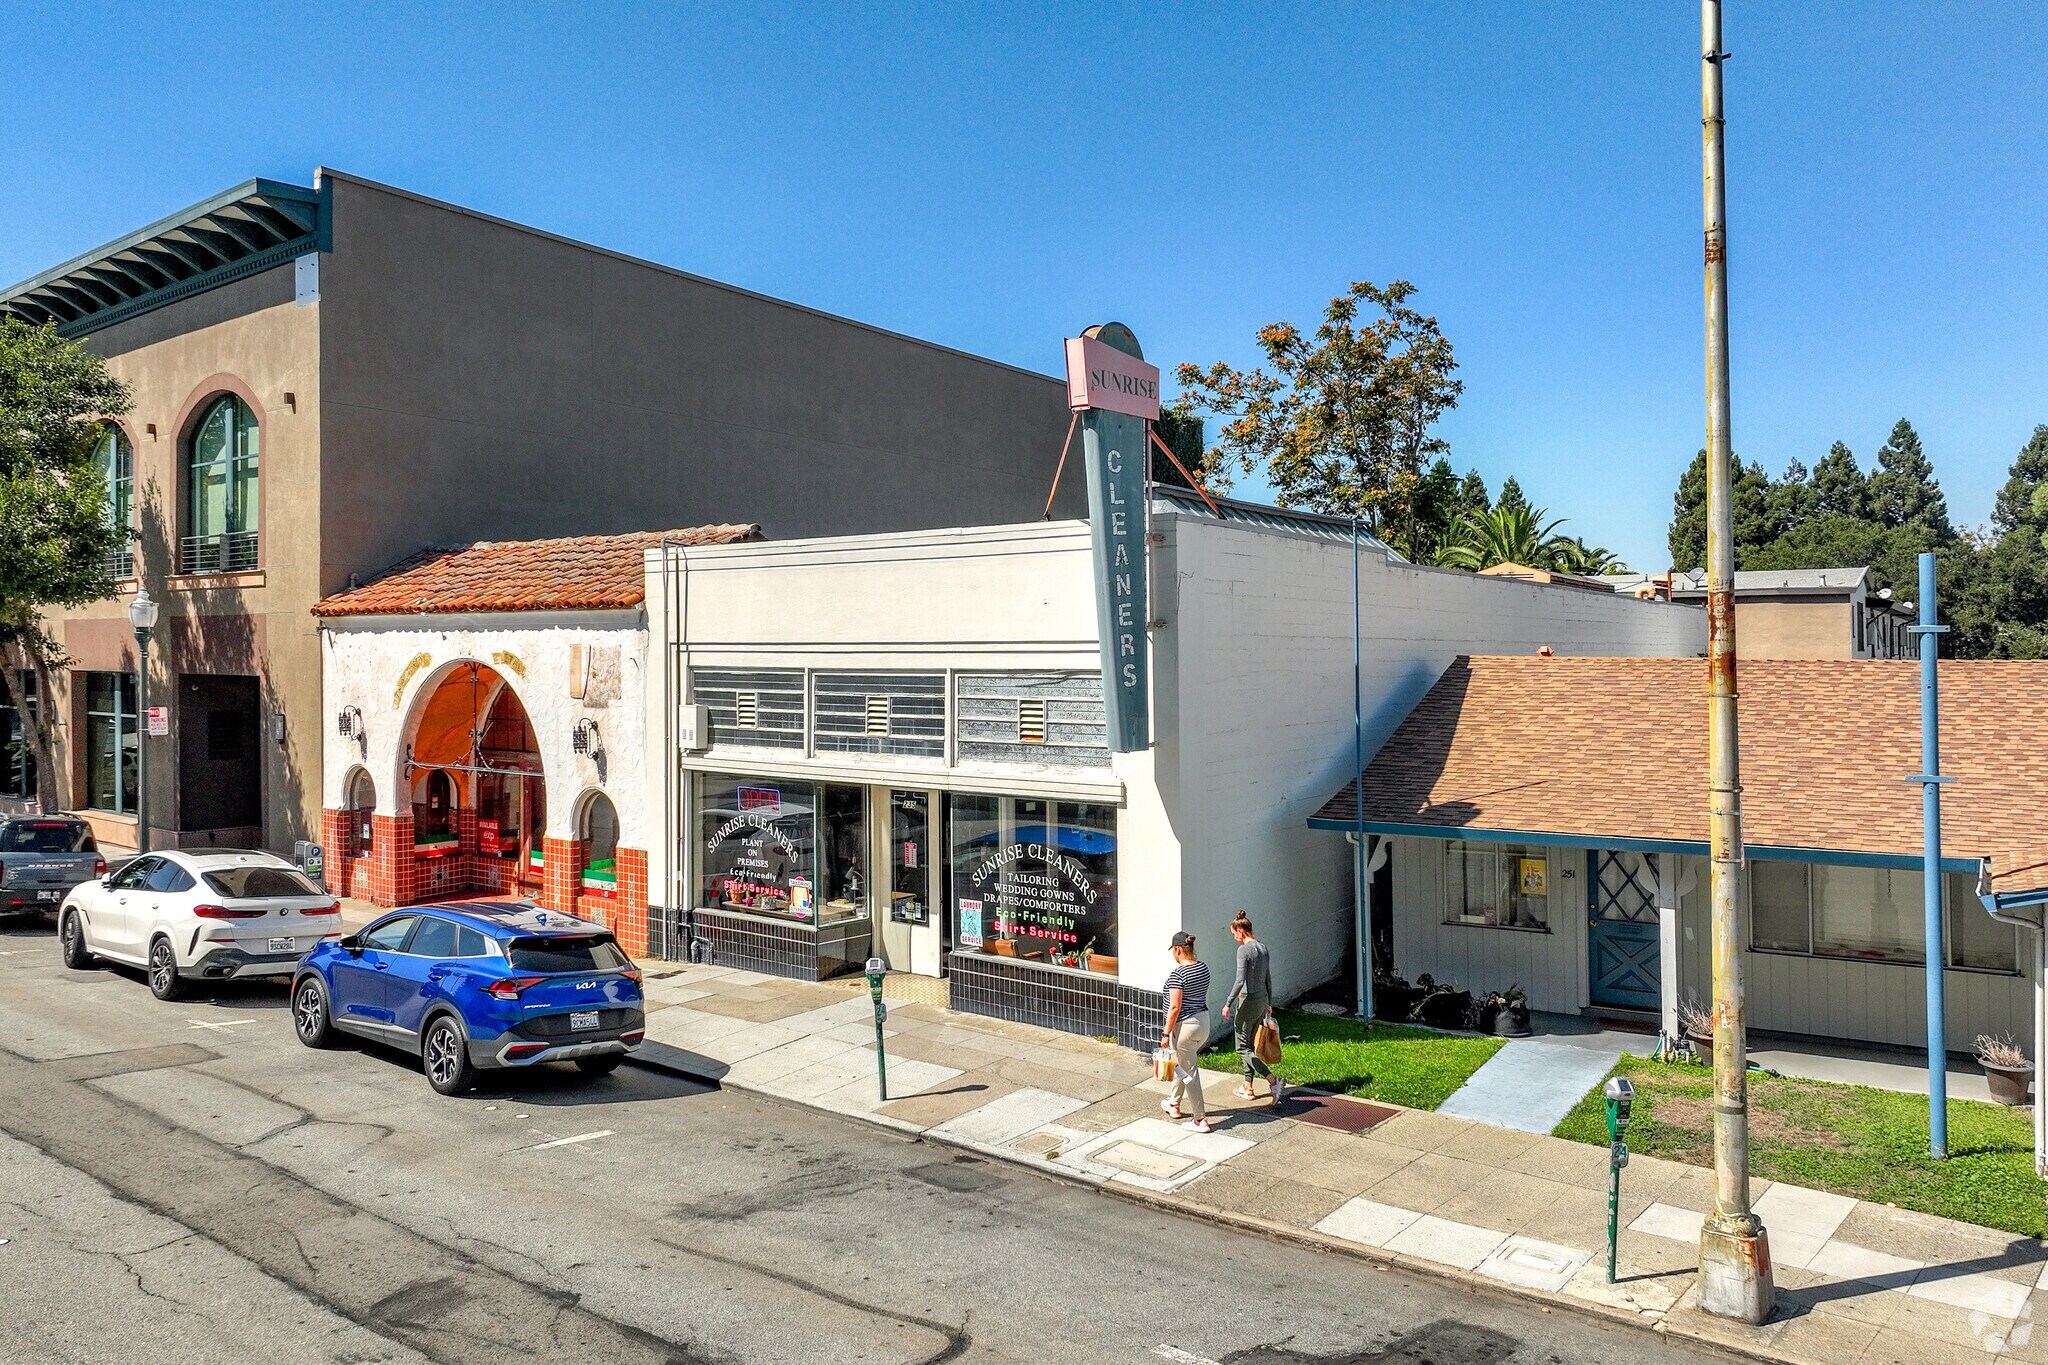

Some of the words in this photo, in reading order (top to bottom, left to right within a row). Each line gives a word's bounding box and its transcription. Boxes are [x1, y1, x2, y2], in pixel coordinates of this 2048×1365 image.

[1091, 368, 1157, 399] SUNRISE
[1107, 449, 1138, 688] CLEANERS
[739, 789, 779, 812] OPEN
[902, 800, 917, 809] 235
[707, 815, 746, 854] SUNRISE
[748, 814, 799, 864] CLEANERS
[741, 838, 764, 848] PLANT
[747, 848, 758, 857] ON
[737, 857, 769, 868] PREMISES
[729, 867, 777, 882] Eco-Friendly
[972, 844, 1024, 888] SUNRISE
[1028, 843, 1098, 905] CLEANERS
[1007, 872, 1059, 887] TAILORING
[1561, 869, 1576, 879] 251
[723, 879, 747, 891] Shirt
[749, 883, 785, 897] Service
[994, 883, 1038, 897] WEDDING
[1040, 888, 1075, 901] GOWNS
[960, 900, 981, 910] LAUNDRY
[983, 893, 1087, 915] DRAPES/COMFORTERS
[995, 907, 1075, 930] Eco-Friendly
[994, 920, 1026, 935] Shirt
[1029, 927, 1078, 943] Service
[961, 935, 982, 945] SERVICE
[1613, 1145, 1627, 1158] 24
